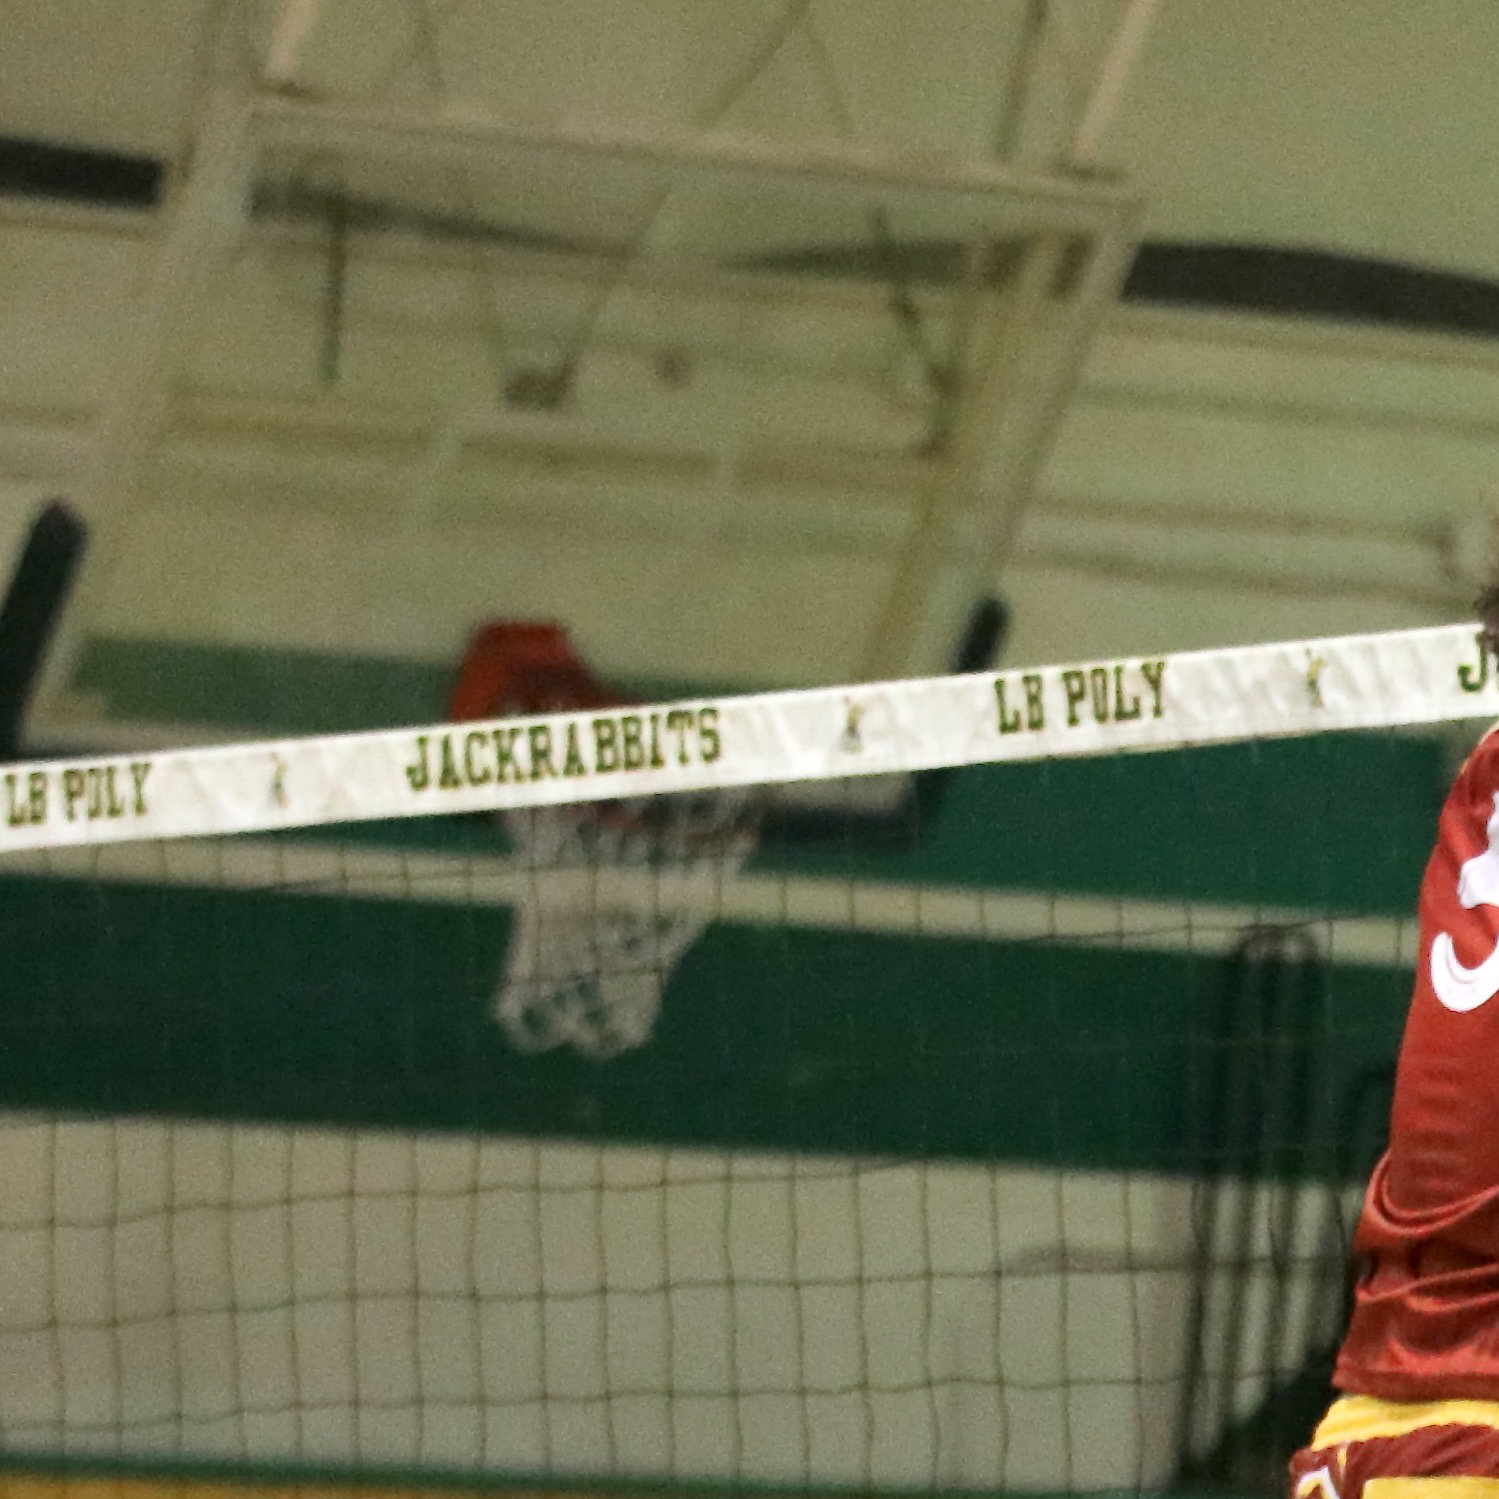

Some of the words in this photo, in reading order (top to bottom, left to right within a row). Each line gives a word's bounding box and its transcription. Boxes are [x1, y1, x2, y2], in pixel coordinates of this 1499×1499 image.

[994, 674, 1044, 735] LB
[1061, 661, 1165, 727] POLY
[405, 706, 721, 792] JACKRABBITS
[4, 772, 48, 827] LB
[63, 762, 151, 822] POLY
